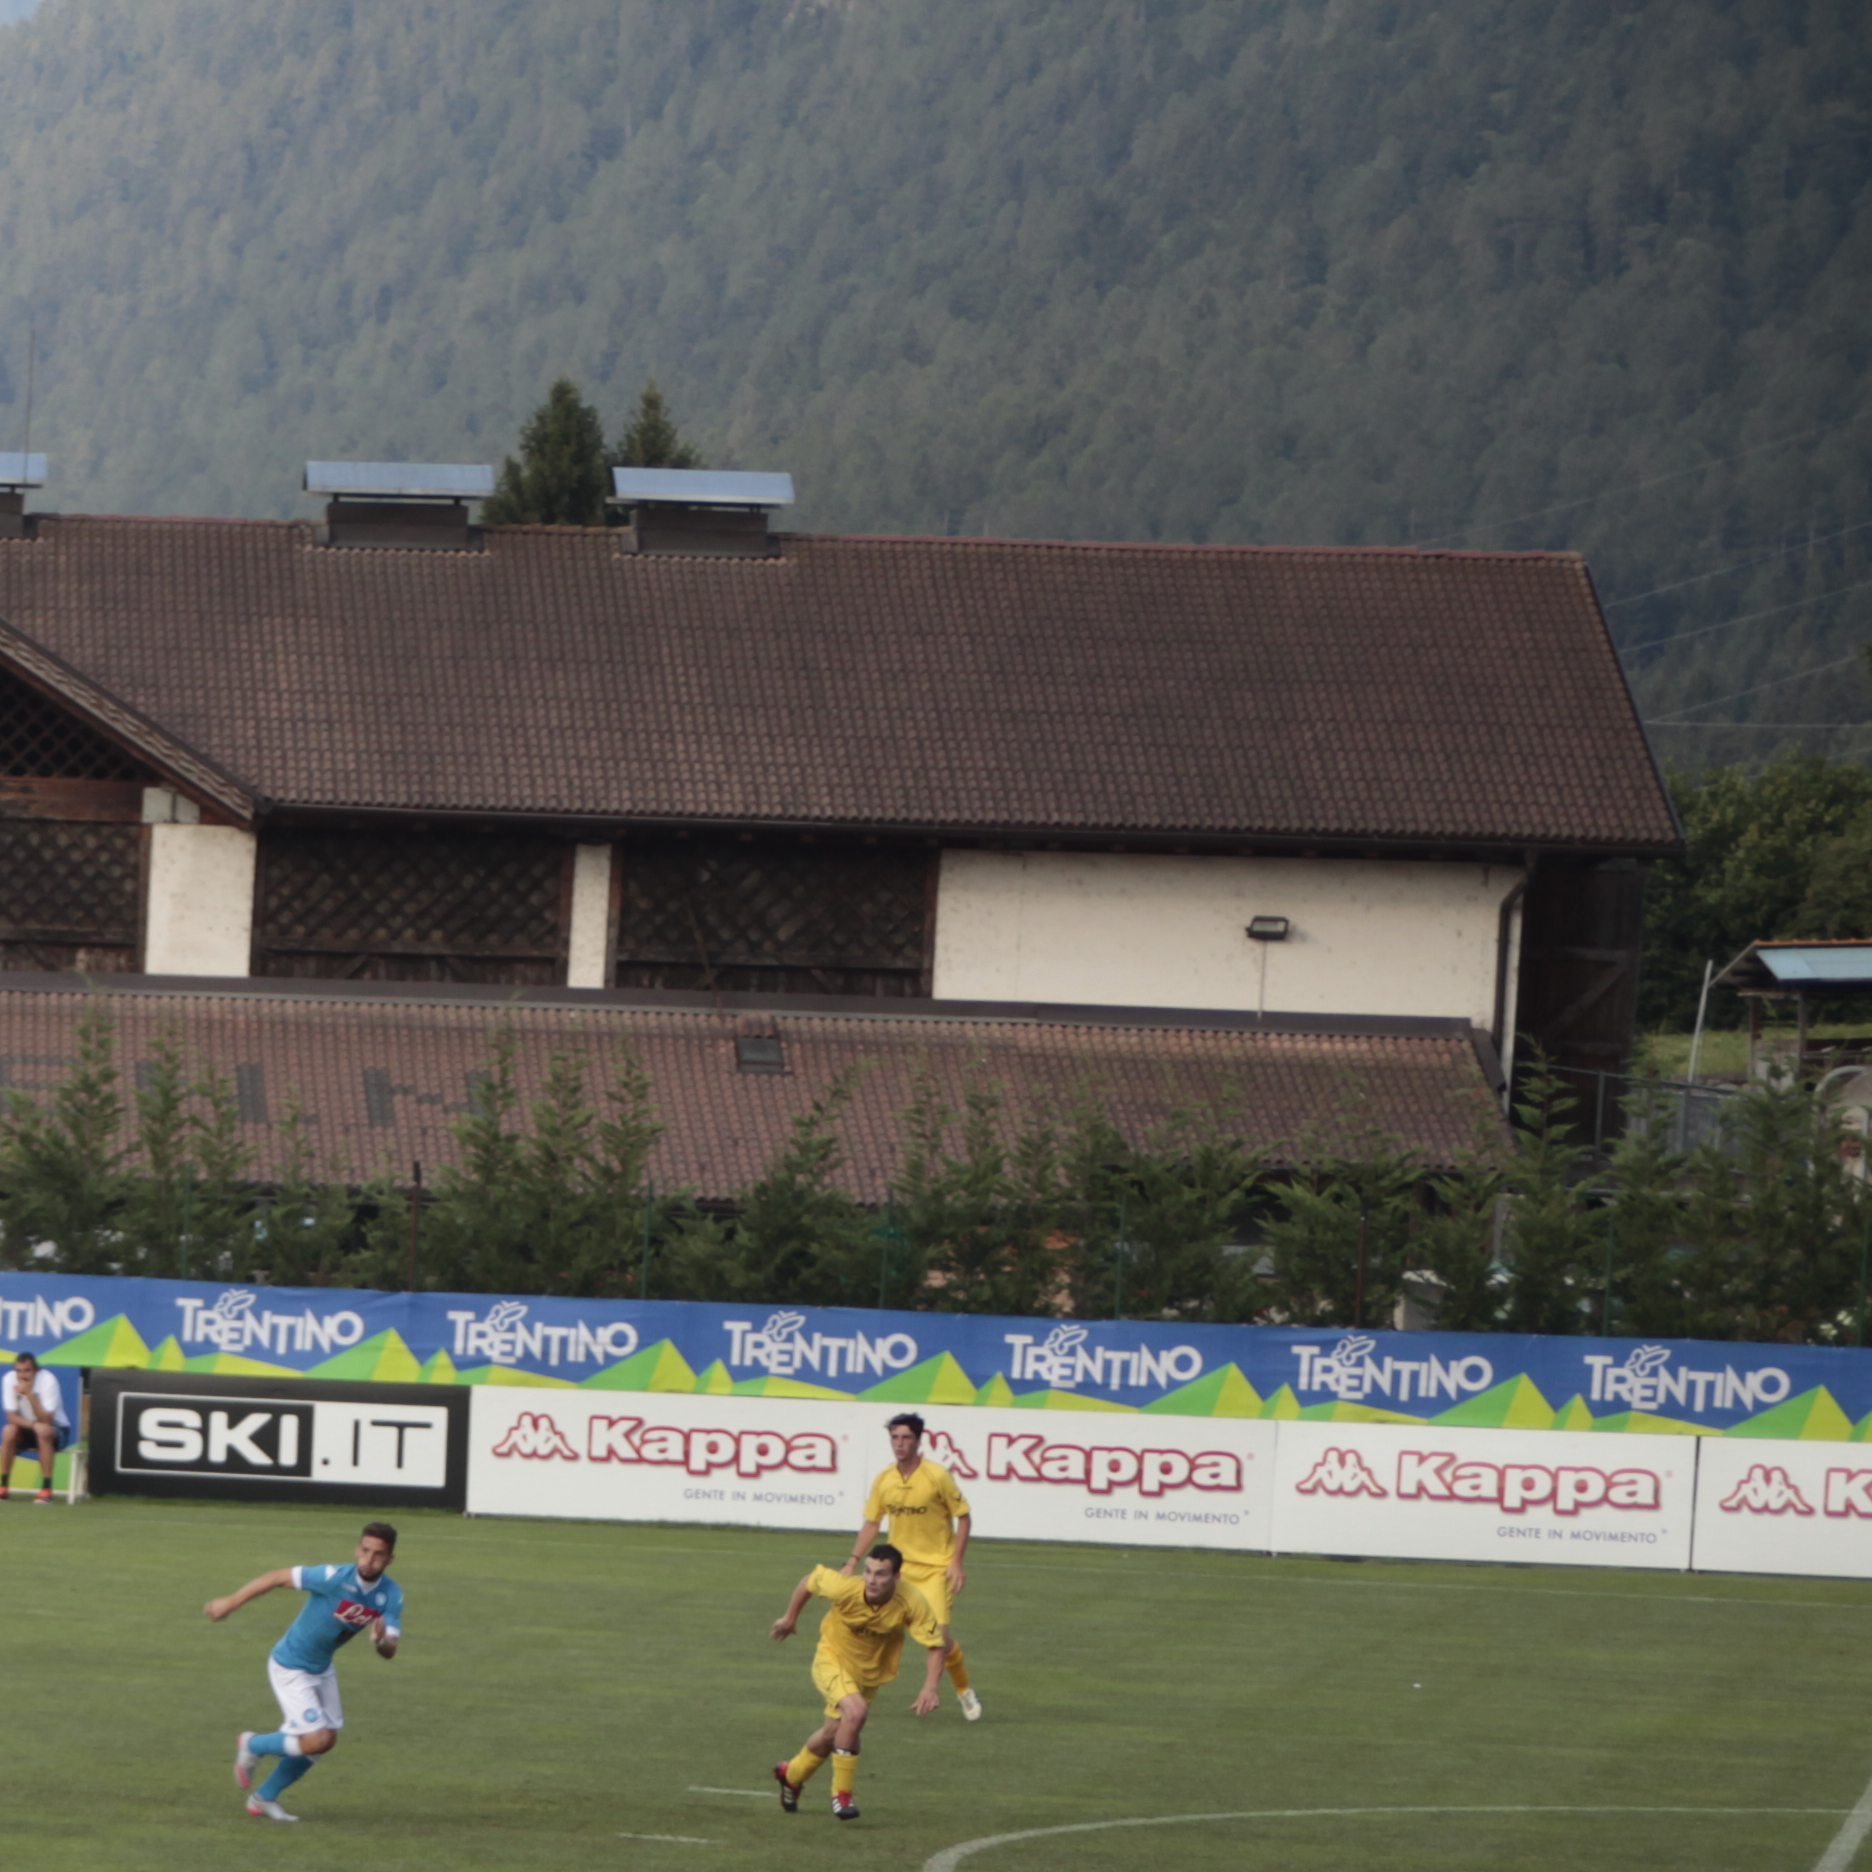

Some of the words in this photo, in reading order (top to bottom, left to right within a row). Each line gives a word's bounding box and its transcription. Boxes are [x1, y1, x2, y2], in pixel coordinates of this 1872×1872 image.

[175, 1297, 365, 1355] TRENTINO
[447, 1310, 639, 1366] TRENTINO
[723, 1321, 919, 1378] TRENTINO
[1004, 1334, 1204, 1390] TRENTINO
[1291, 1345, 1495, 1402] TRENTINO
[1583, 1355, 1792, 1412] TRENTINO
[137, 1407, 433, 1469] SKI.IT
[588, 1415, 838, 1478] Kappa
[987, 1433, 1243, 1498] Kappa
[683, 1488, 725, 1501] GENTE
[732, 1490, 746, 1502] IN
[753, 1492, 835, 1506] MOVIMENTO
[1396, 1450, 1661, 1516] Kappa
[1084, 1507, 1128, 1520] GENTE
[1134, 1510, 1149, 1521] IN
[1156, 1512, 1240, 1525] MOVIMENTO
[1496, 1526, 1542, 1540] GENTE
[1548, 1528, 1563, 1541] IN
[1570, 1530, 1658, 1544] MOVIMENTO
